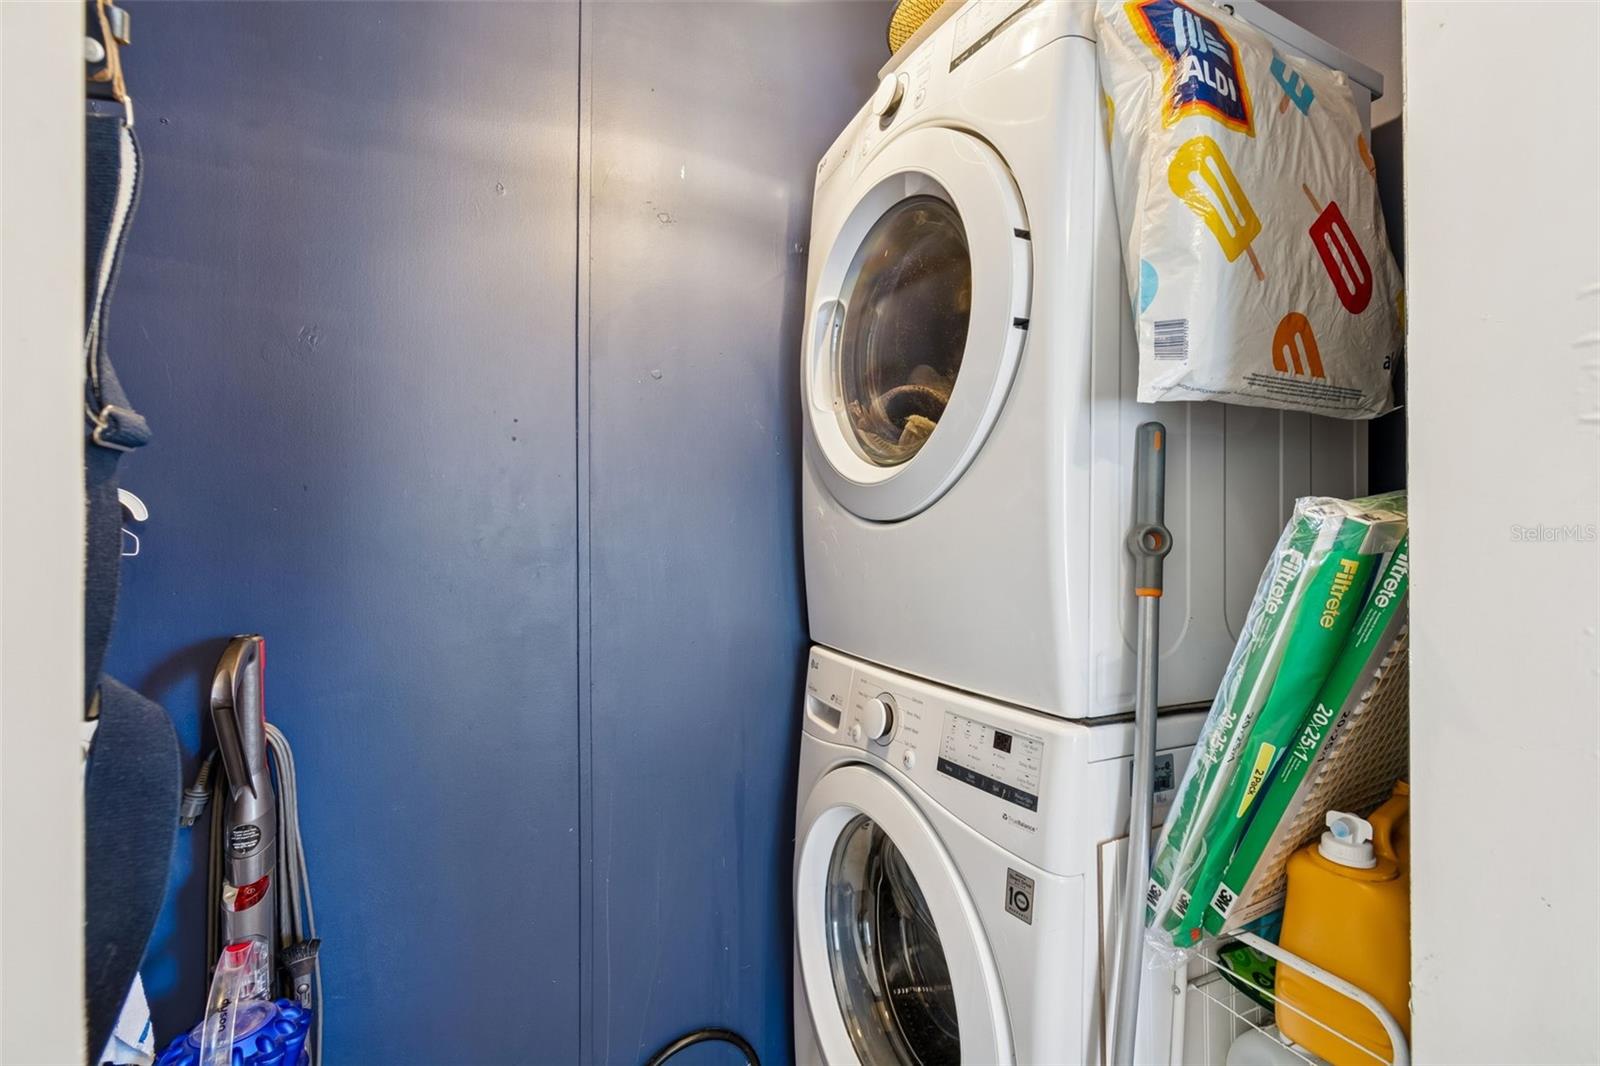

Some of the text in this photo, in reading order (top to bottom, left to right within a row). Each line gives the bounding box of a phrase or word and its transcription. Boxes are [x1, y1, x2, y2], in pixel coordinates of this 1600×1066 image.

[1179, 54, 1237, 102] ALDI
[1266, 549, 1304, 615] Filtrete
[1320, 559, 1360, 629] Filtrete
[1294, 703, 1333, 762] 20x25x1
[1247, 769, 1265, 795] 2 Pack
[1009, 886, 1030, 912] 10
[1147, 884, 1162, 907] 3M
[1214, 888, 1233, 913] 3M
[217, 998, 231, 1032] dyson
